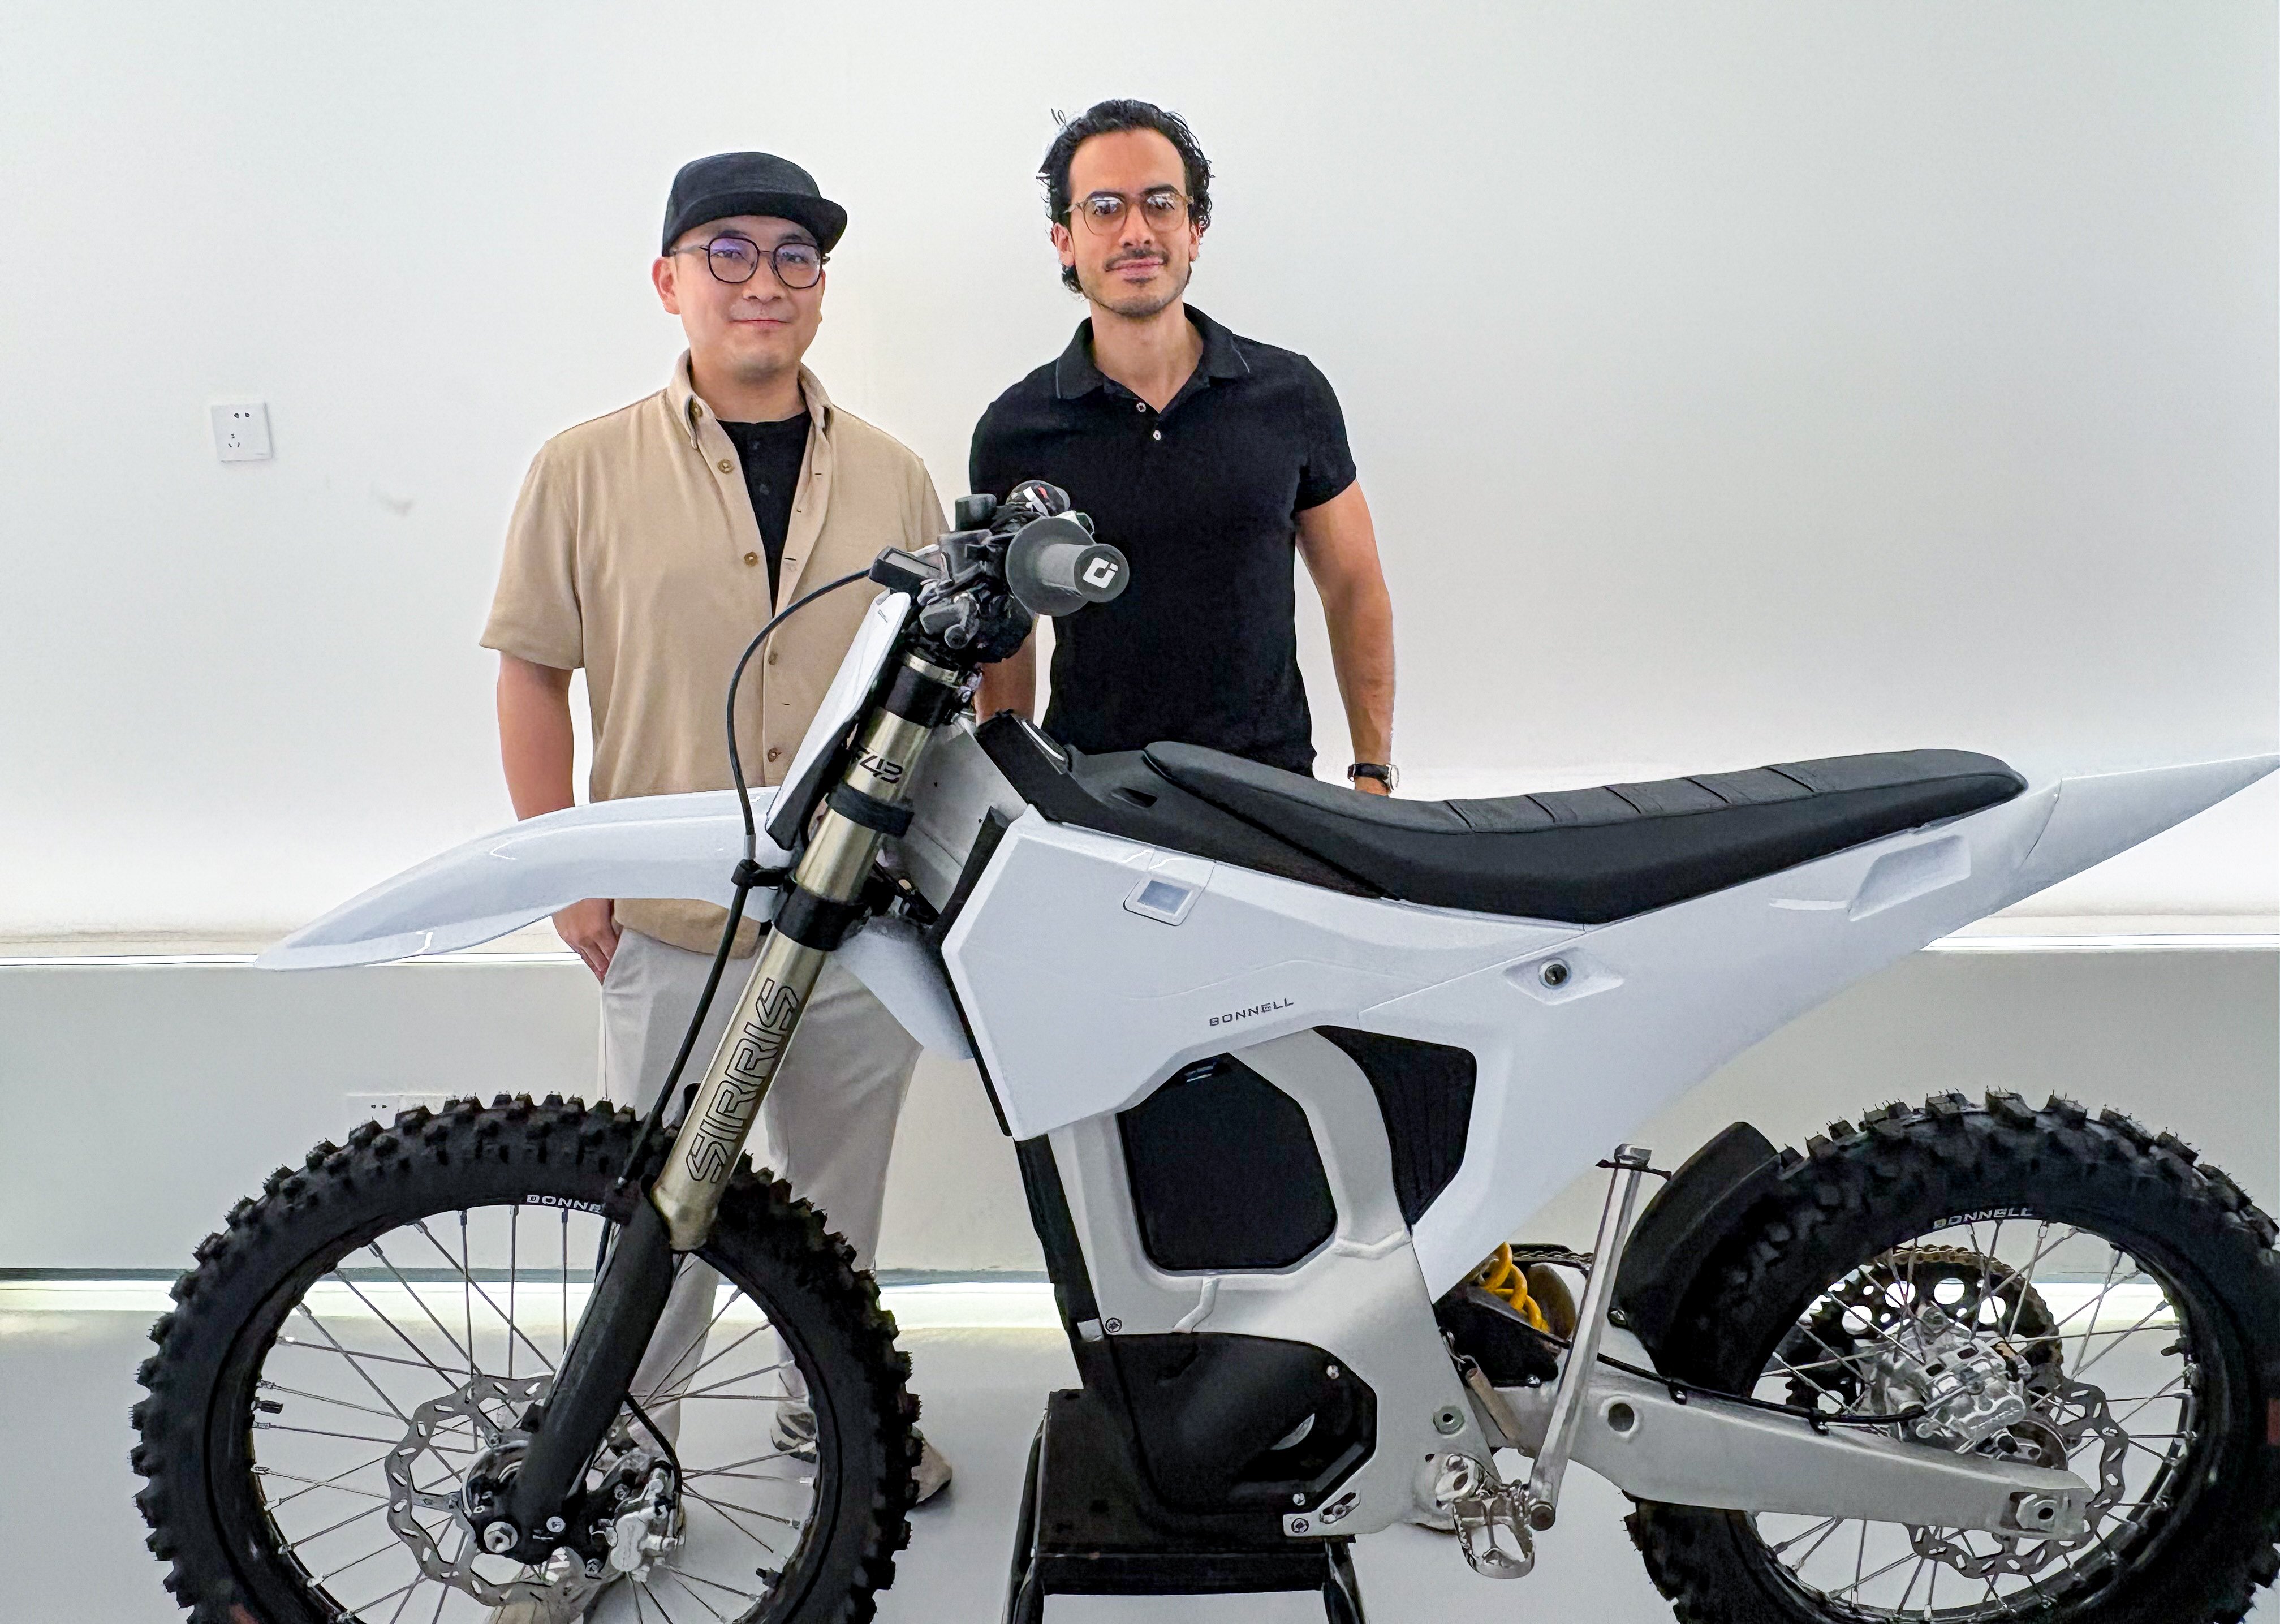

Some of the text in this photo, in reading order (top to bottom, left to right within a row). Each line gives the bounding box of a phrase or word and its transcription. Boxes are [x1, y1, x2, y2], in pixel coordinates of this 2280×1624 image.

[1209, 997, 1294, 1027] BONNELL
[686, 977, 799, 1184] SIRRIS
[527, 1194, 606, 1214] BONNE
[1933, 1208, 2033, 1229] BONNELL
